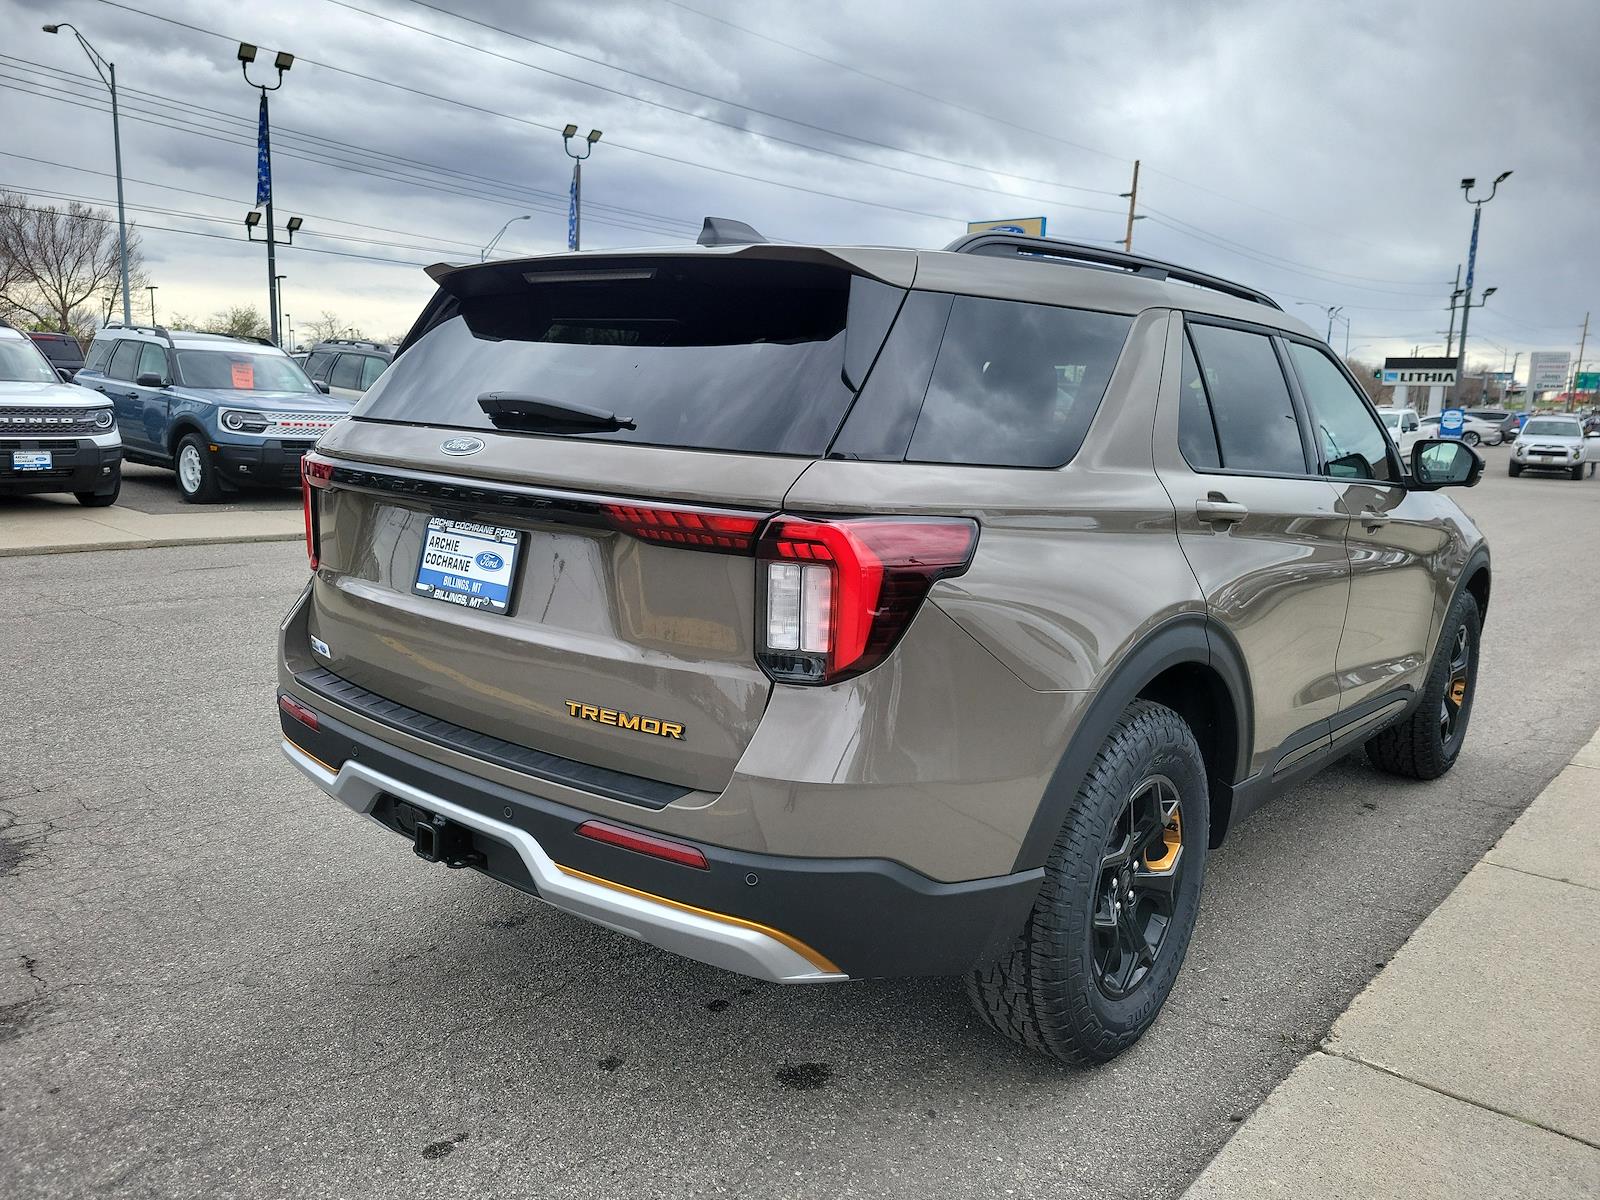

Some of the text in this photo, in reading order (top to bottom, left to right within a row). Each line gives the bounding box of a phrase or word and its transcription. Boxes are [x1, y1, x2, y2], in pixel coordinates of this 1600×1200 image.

[1400, 372, 1455, 383] LITHIA
[429, 517, 516, 539] ARCHIE COCHRANE FORD
[428, 535, 460, 552] ARCHIE
[425, 552, 471, 573] COCHRANE
[479, 553, 500, 569] Ford
[443, 575, 482, 594] BILLINGS, MT
[433, 589, 482, 608] BILLINGS, MT
[565, 699, 686, 740] TREMOR
